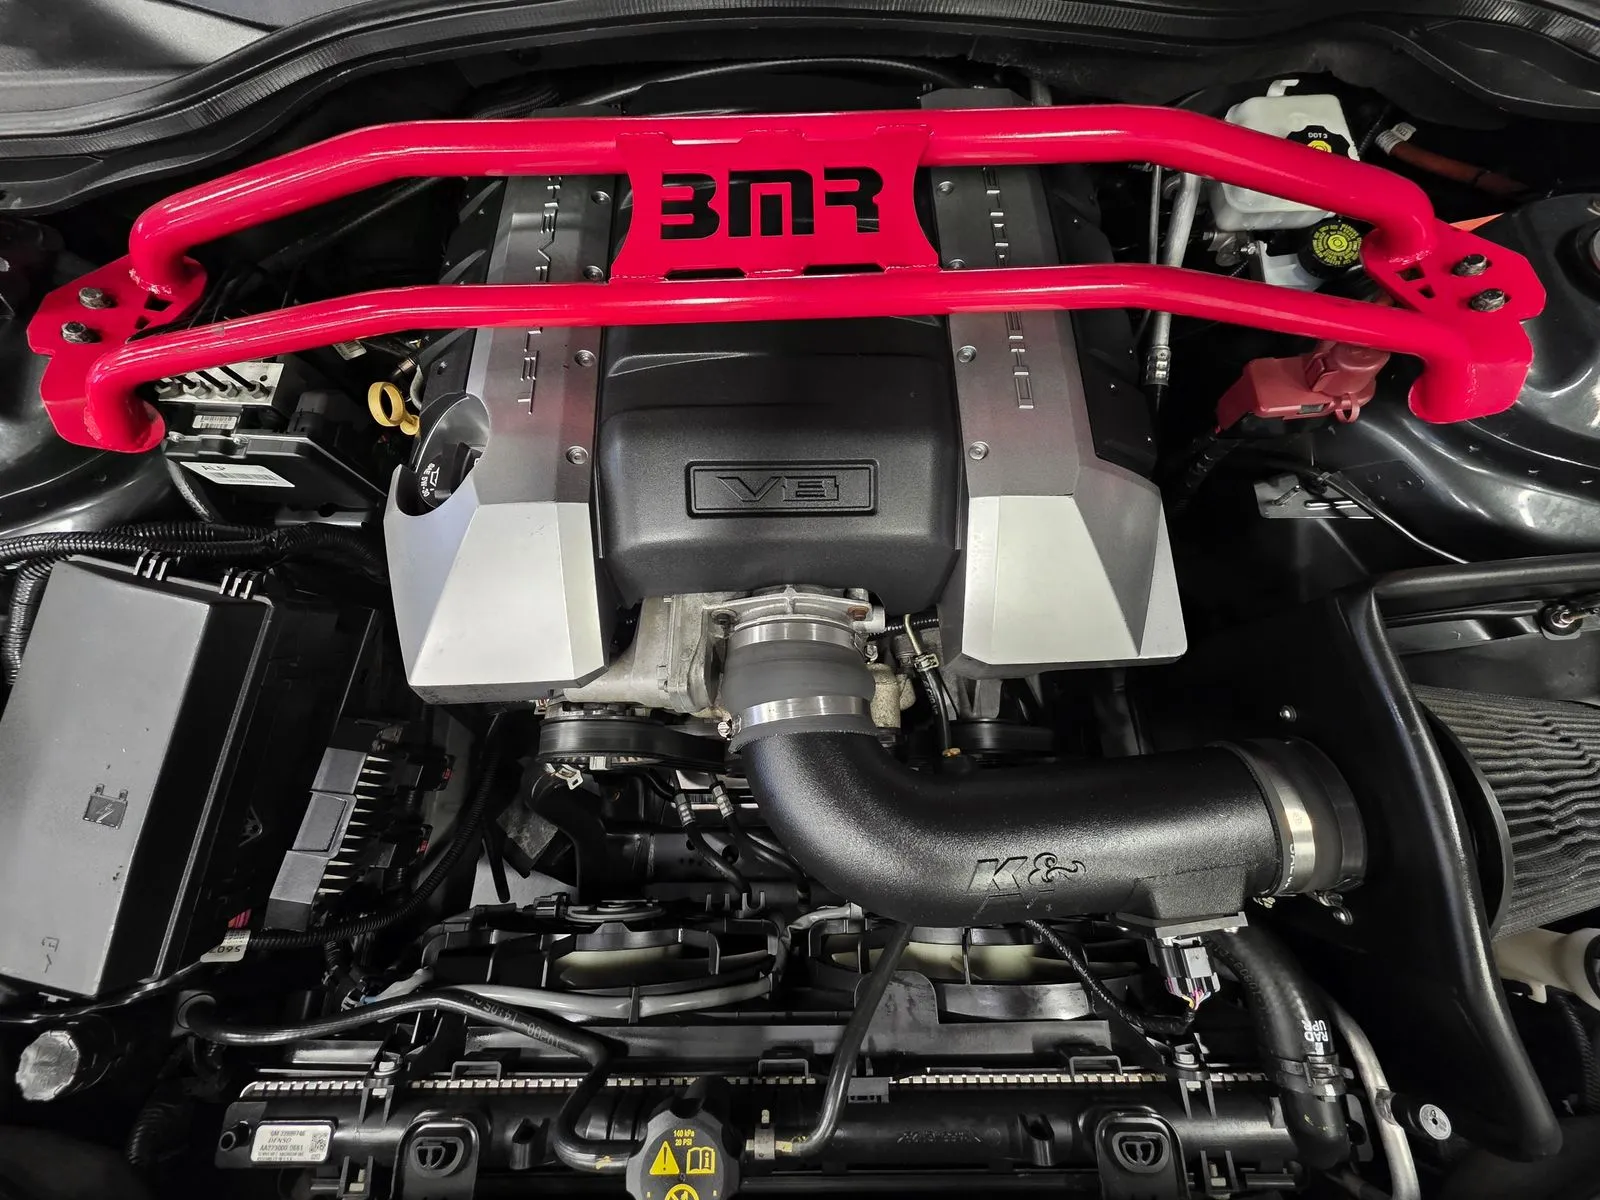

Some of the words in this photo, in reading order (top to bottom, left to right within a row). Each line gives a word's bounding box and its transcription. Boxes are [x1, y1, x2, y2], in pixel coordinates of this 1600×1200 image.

[660, 166, 884, 240] BMR
[423, 462, 436, 475] SAE
[716, 474, 840, 504] V8
[1301, 1019, 1327, 1032] UPR
[1303, 1031, 1329, 1042] RAD
